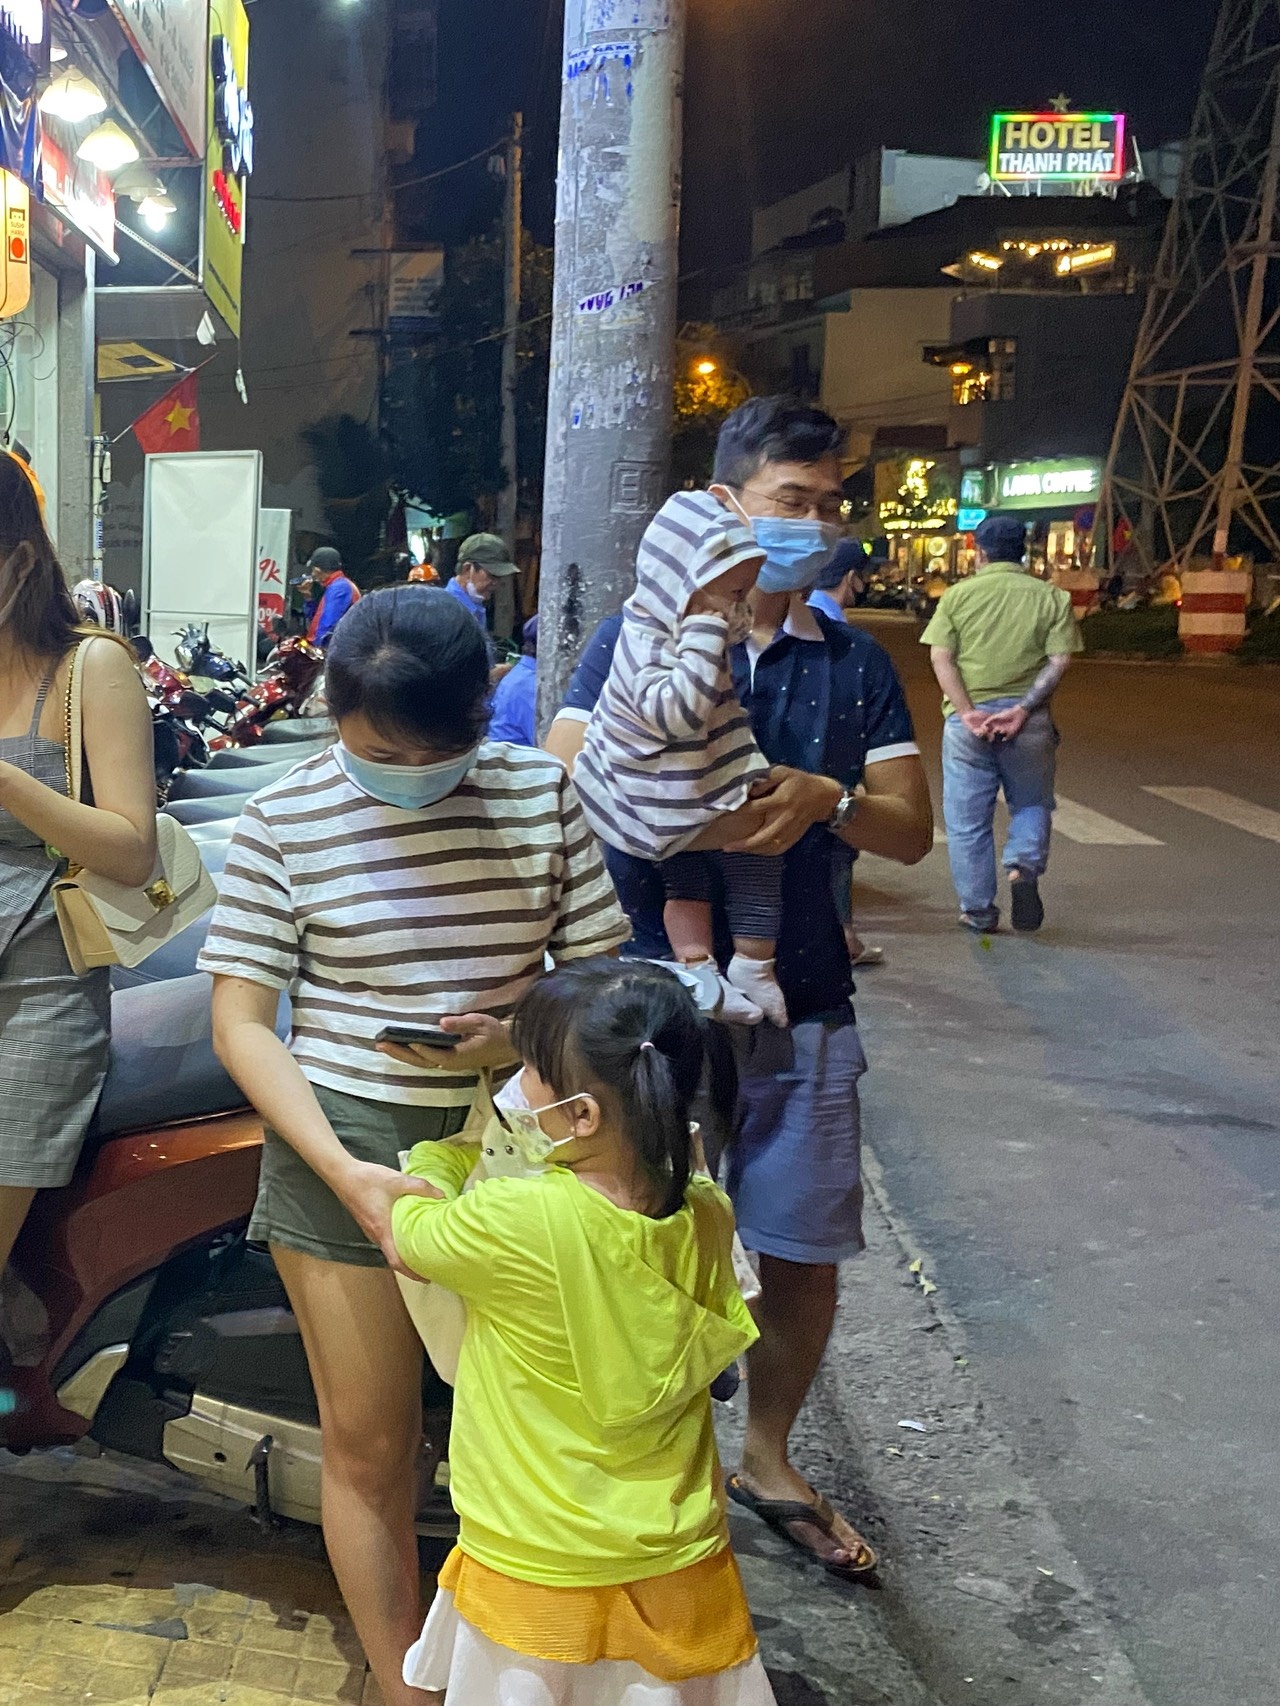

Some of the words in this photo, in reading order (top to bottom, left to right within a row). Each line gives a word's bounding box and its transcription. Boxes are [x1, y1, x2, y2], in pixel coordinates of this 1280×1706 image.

[1005, 122, 1111, 150] HOTEL
[1066, 149, 1115, 173] PHÁT
[1042, 469, 1094, 494] COFFEE
